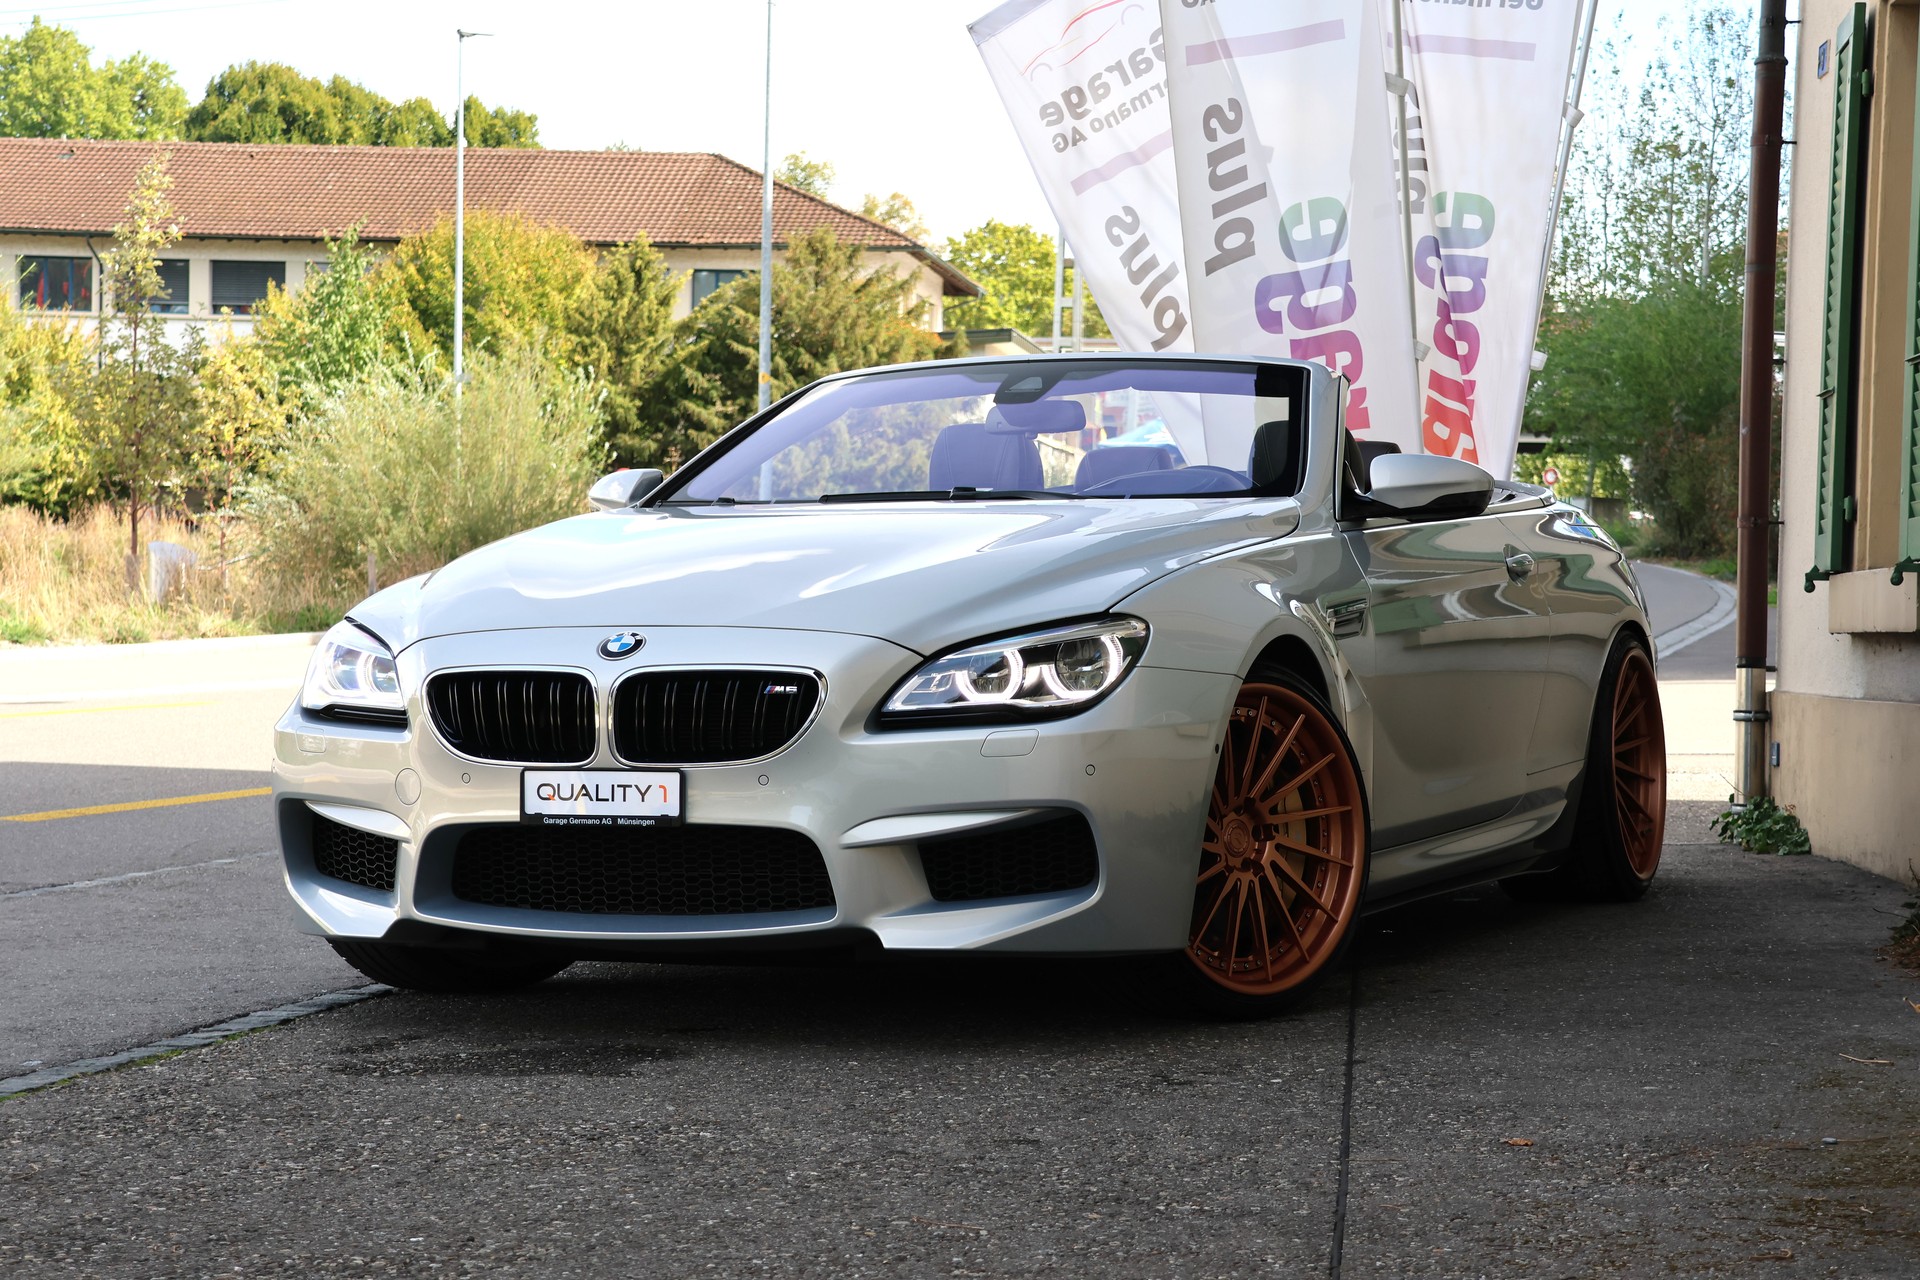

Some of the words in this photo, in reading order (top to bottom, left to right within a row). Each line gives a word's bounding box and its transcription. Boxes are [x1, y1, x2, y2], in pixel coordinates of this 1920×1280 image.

[537, 783, 652, 802] QUALITY
[543, 817, 567, 825] Garage
[569, 817, 600, 825] Germano
[617, 818, 655, 826] Münsingen
